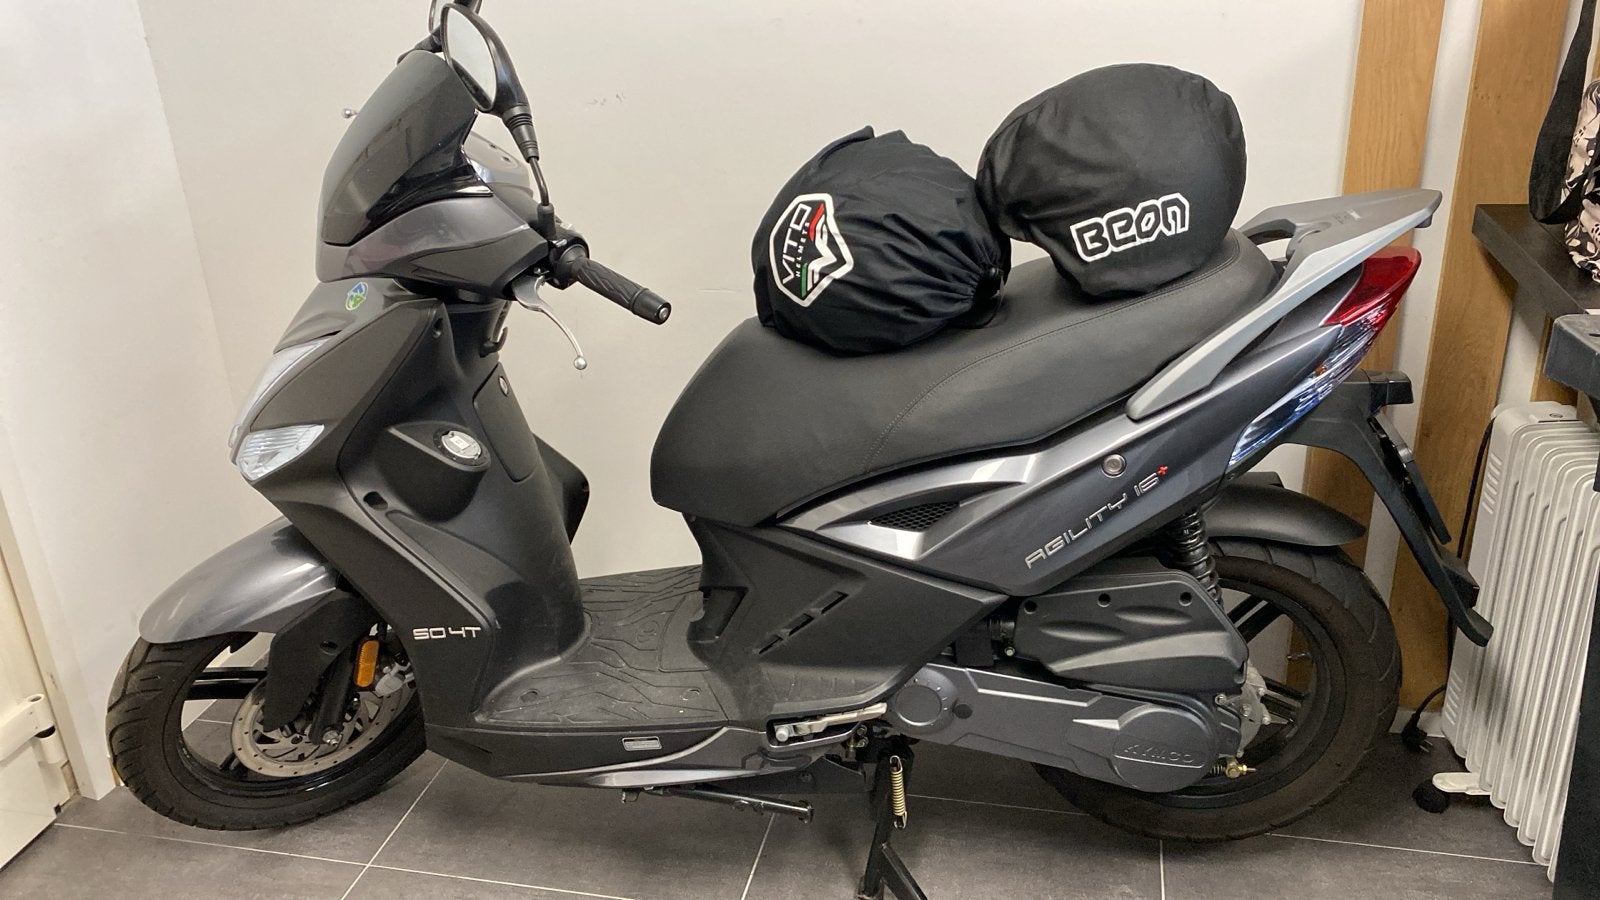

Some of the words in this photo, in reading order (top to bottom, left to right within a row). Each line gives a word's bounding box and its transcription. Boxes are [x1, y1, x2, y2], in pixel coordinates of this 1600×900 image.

[782, 203, 812, 284] VITO
[795, 221, 810, 278] HELMETS
[1024, 492, 1128, 569] AGILITY
